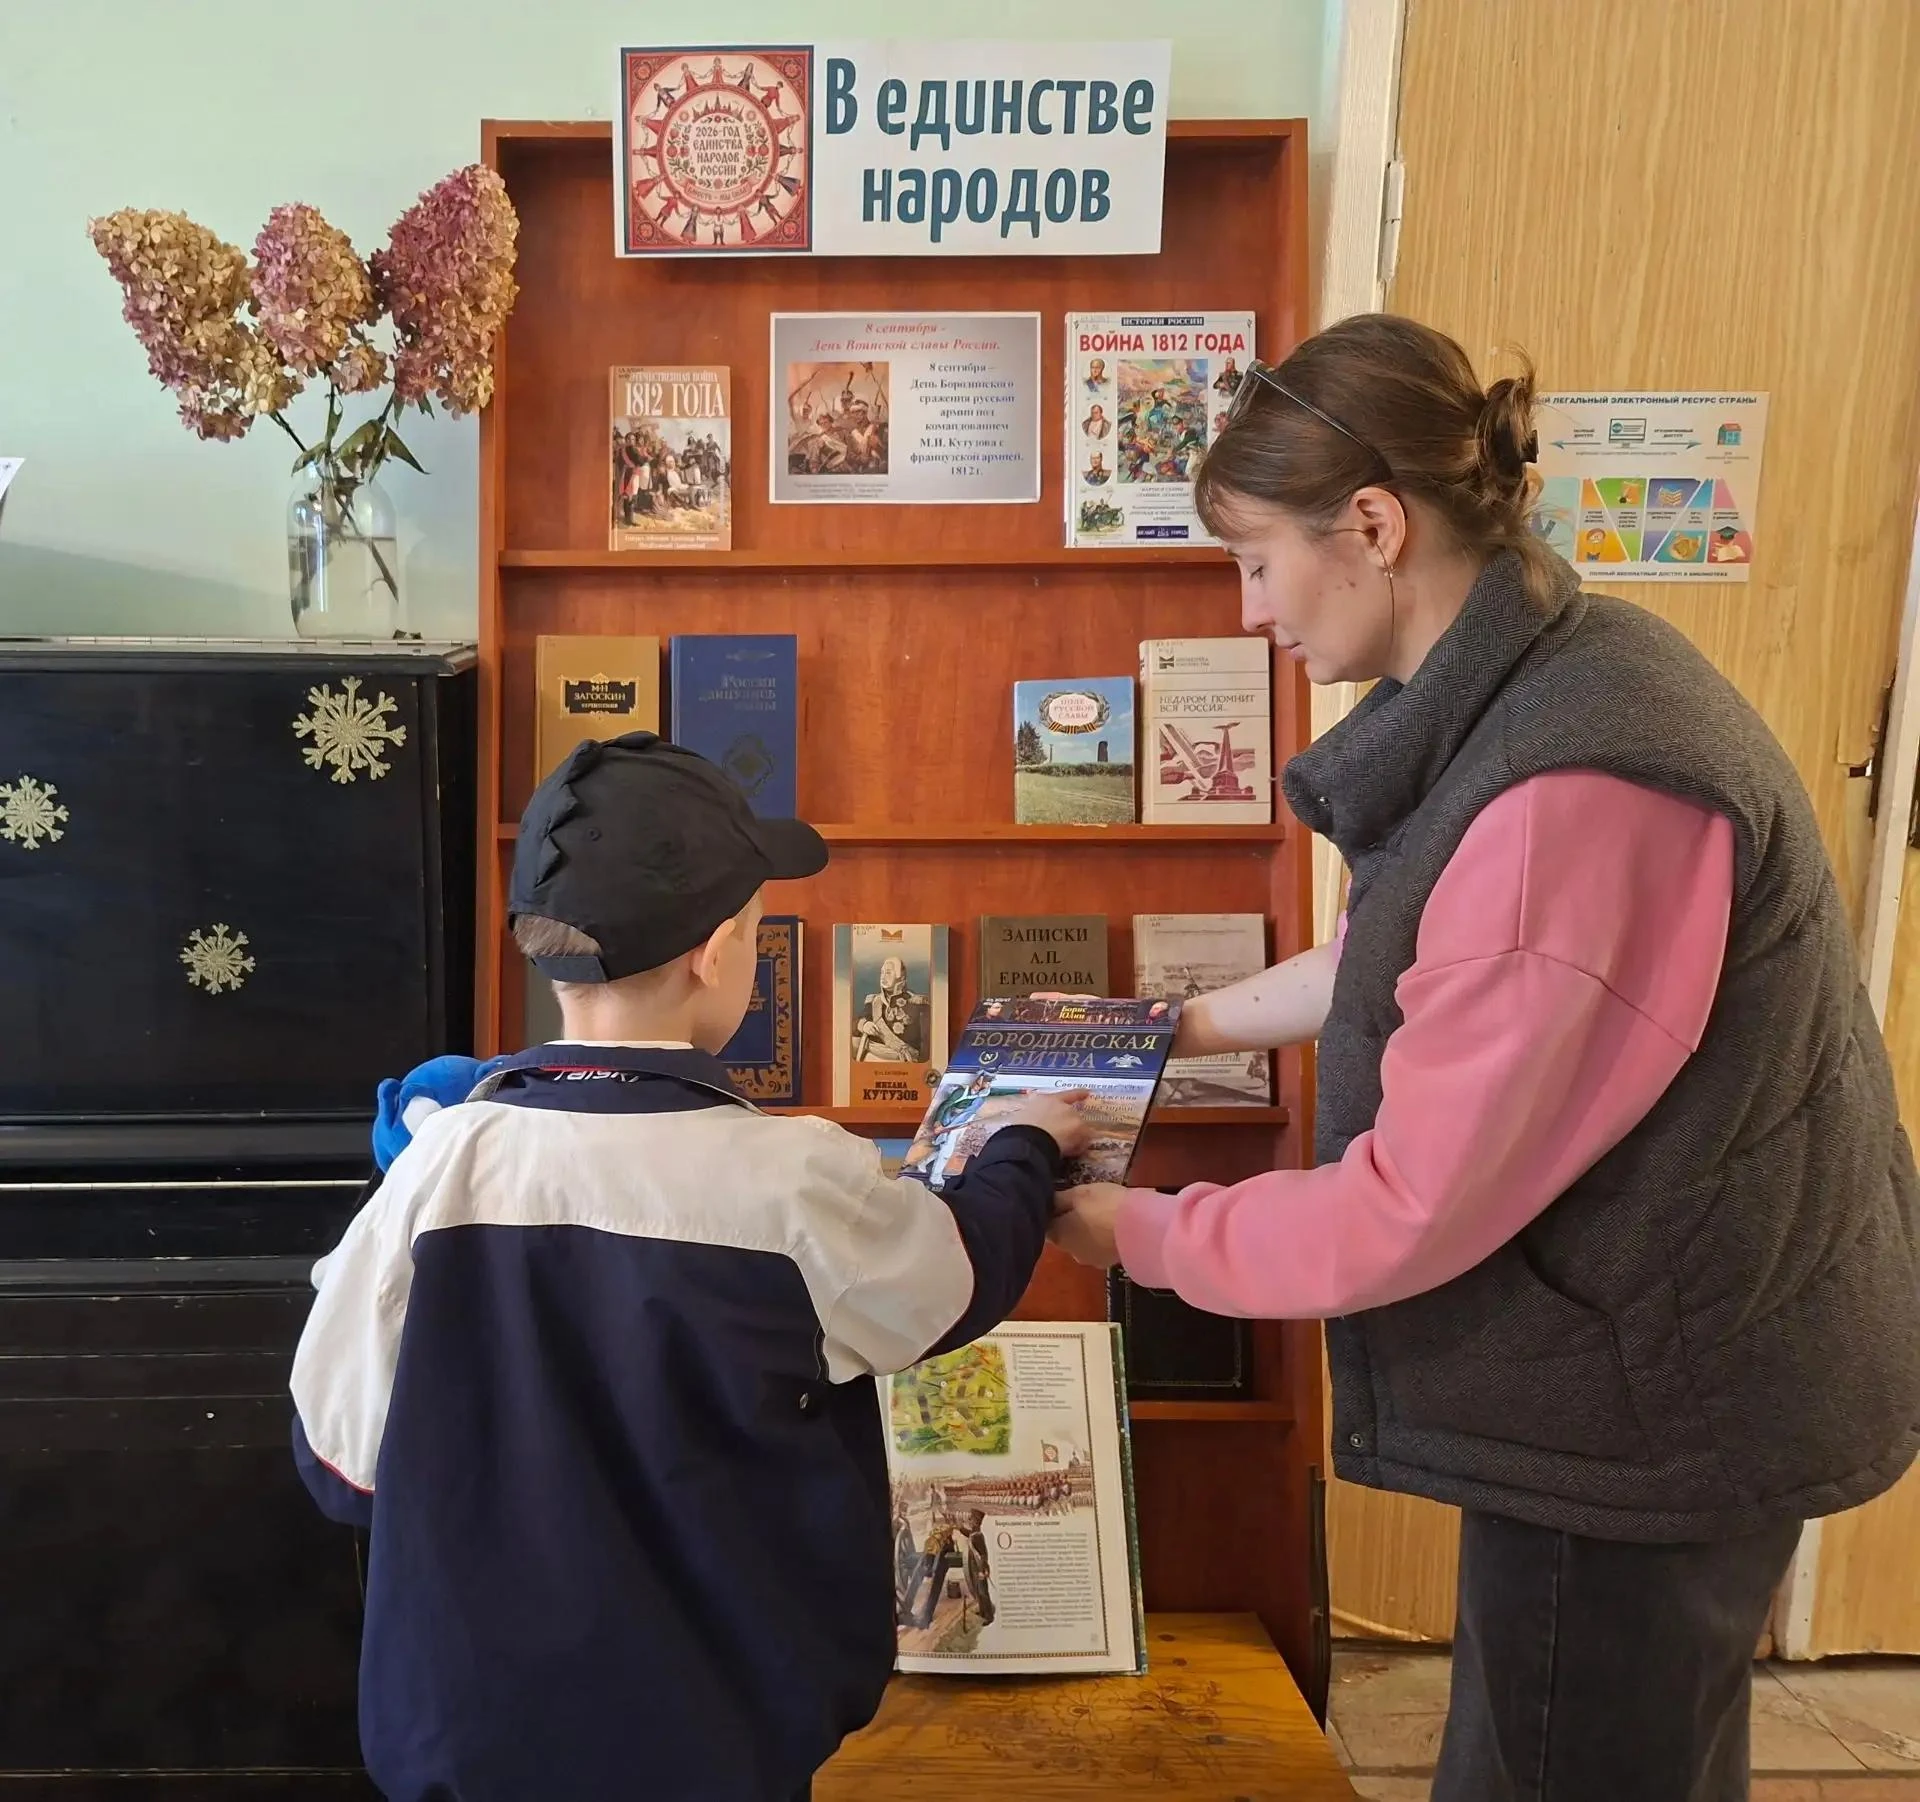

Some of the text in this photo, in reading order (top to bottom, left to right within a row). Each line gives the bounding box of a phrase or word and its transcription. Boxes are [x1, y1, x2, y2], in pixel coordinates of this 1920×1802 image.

[826, 57, 1155, 151] В единстве
[696, 151, 740, 164] НАРОДОВ
[700, 164, 737, 176] РОССИИ
[862, 167, 1111, 243] народов
[1122, 318, 1204, 326] ИСТОРИЯ РОССИИ
[865, 323, 873, 334] 8
[875, 322, 937, 336] сентября
[811, 339, 842, 352] День
[910, 341, 949, 351] славы
[1079, 330, 1245, 354] ВОЙНА 1812 ГОДА
[929, 363, 936, 371] 8
[938, 362, 986, 374] сентября
[910, 376, 938, 391] День
[625, 382, 725, 419] 1812 ГОДА
[1611, 396, 1679, 404] ЭЛЕКТРОННЫЙ
[1682, 396, 1717, 404] РЕСУРС
[1719, 396, 1757, 404] СТРАНЫ
[574, 692, 626, 700] ЗАГОСКИН
[1160, 694, 1256, 704] НЕДАРОМ ПОМНИТ
[1160, 704, 1178, 712] ВСЯ
[1002, 928, 1088, 942] ЗАПИСКИ
[999, 971, 1095, 985] ЕРМОЛОВА
[971, 1032, 1160, 1050] БОРОДИНСКАЯ
[1008, 1050, 1096, 1068] БИТВА
[862, 1088, 919, 1101] КУТУЗОВ
